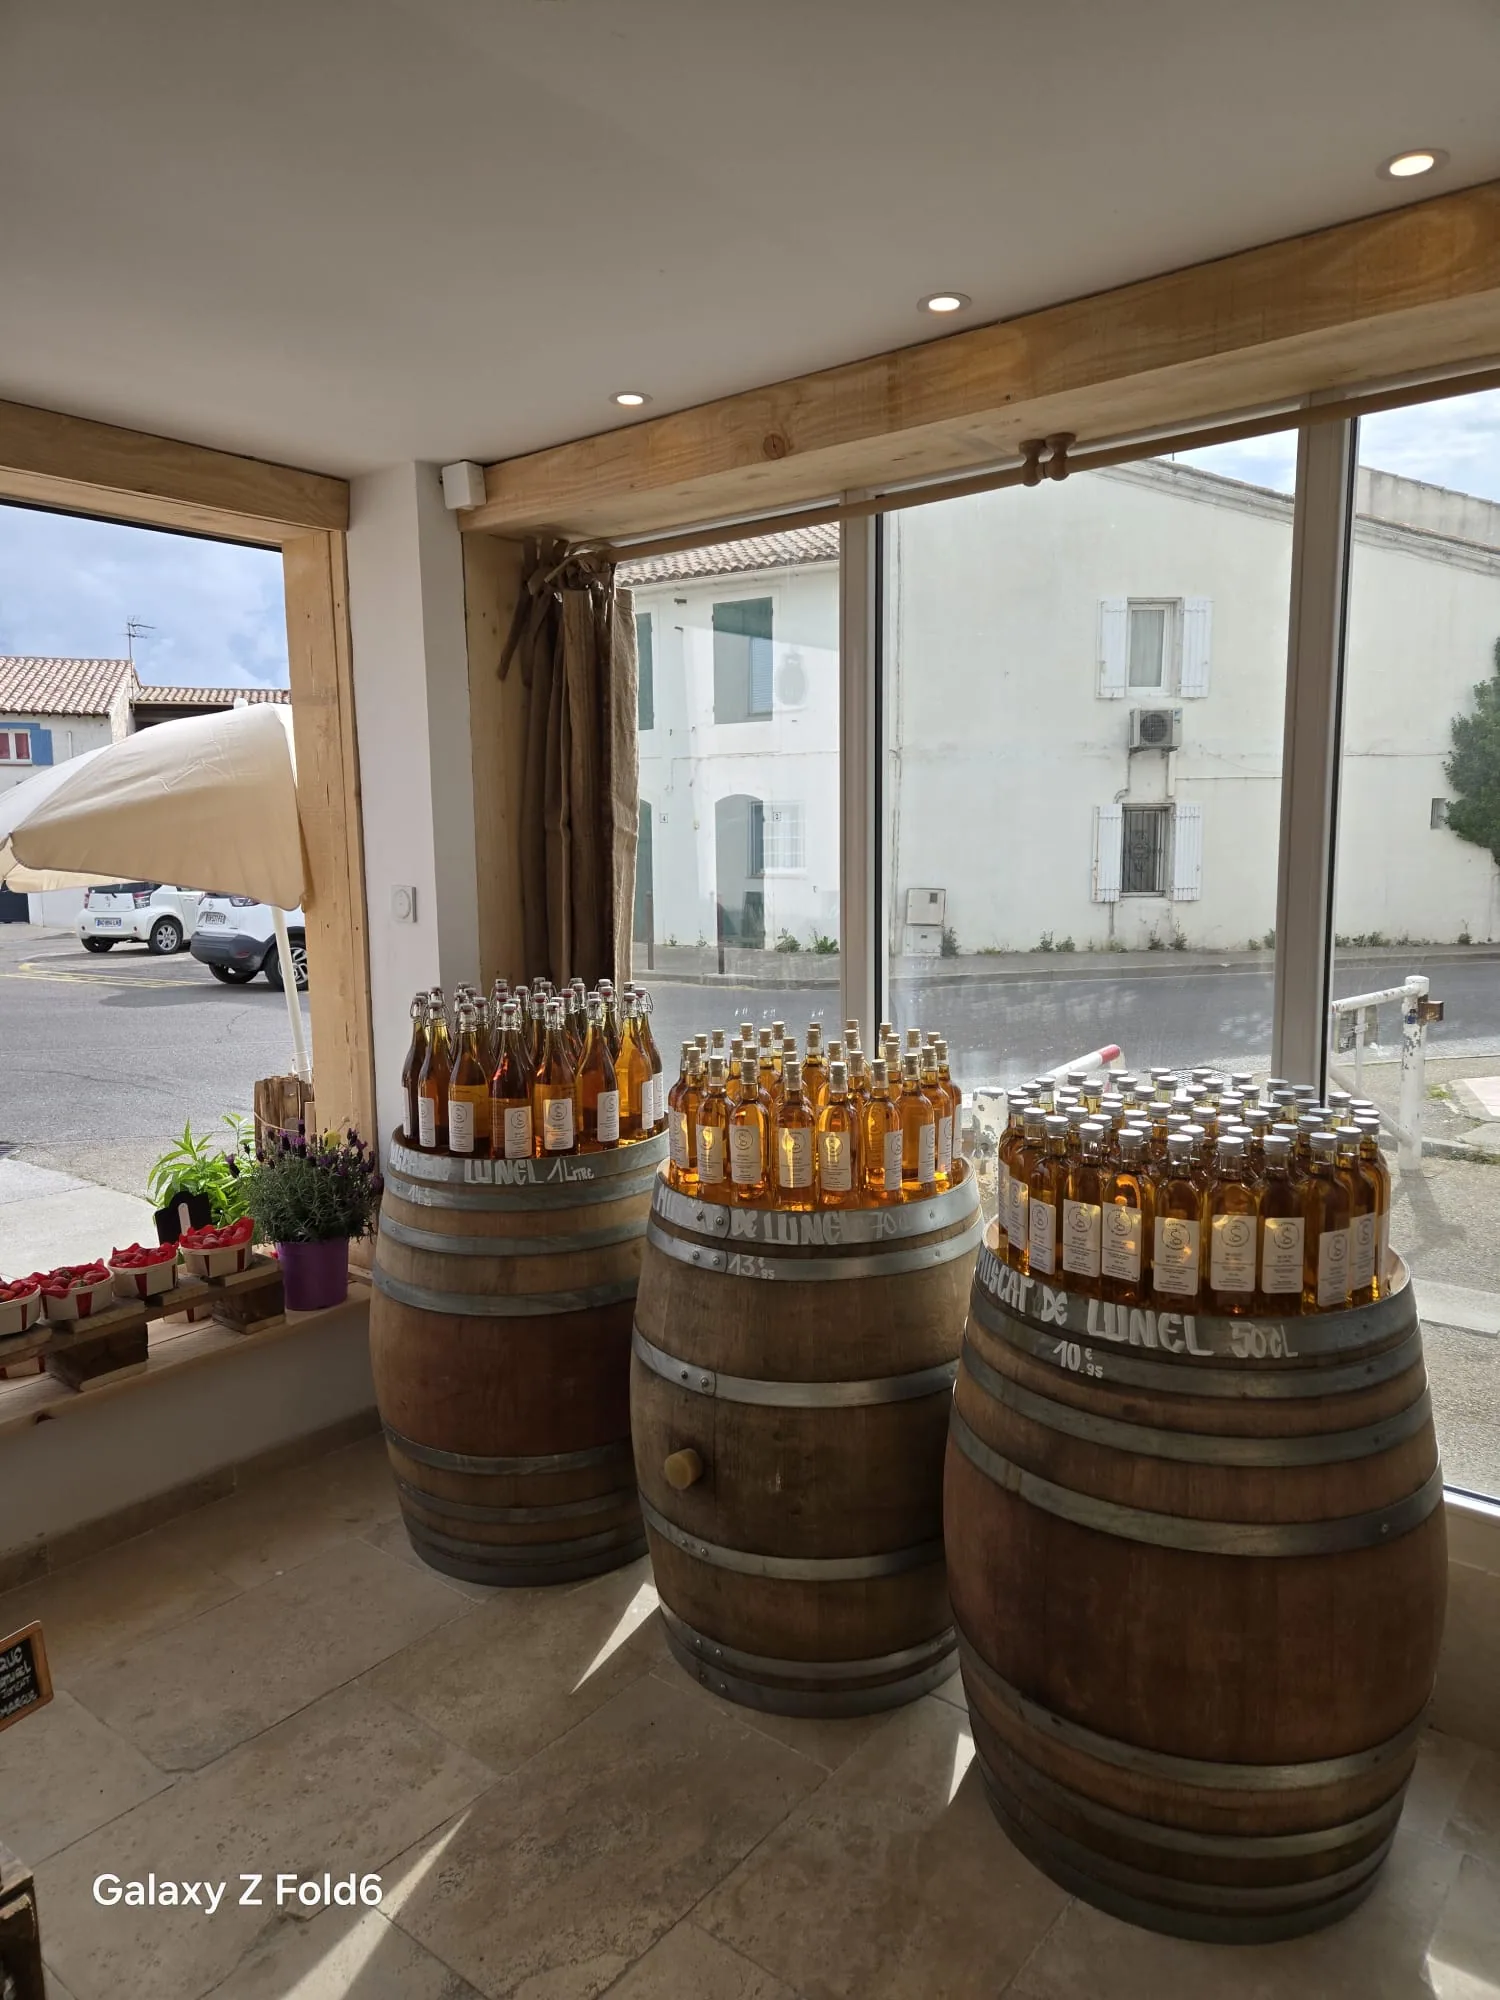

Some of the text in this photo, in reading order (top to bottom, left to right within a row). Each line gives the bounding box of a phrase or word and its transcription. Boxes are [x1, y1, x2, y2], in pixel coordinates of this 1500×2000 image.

[464, 1159, 544, 1185] LUNEL
[1041, 1285, 1068, 1326] DE
[1087, 1298, 1215, 1356] LUNEL
